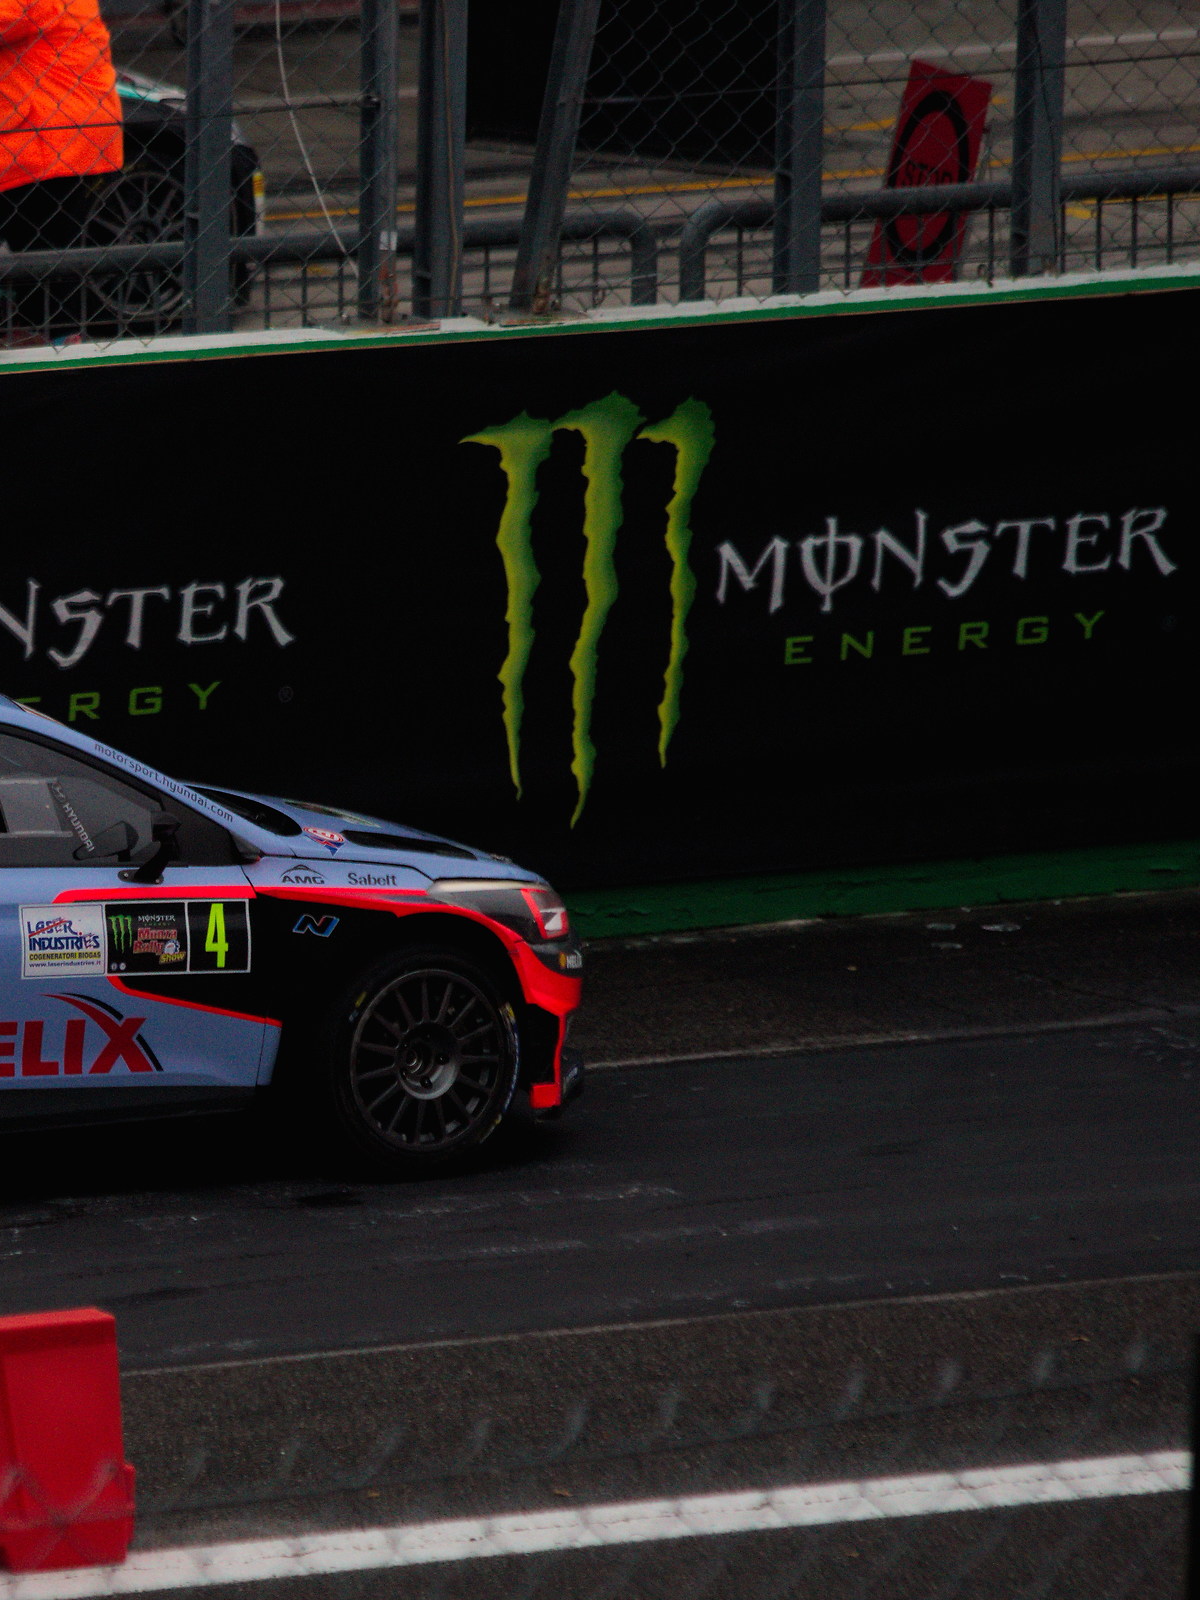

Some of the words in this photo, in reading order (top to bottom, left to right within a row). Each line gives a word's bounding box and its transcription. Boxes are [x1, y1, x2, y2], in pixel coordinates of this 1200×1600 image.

[715, 505, 1178, 615] MONSTER
[782, 610, 1106, 665] ENERGY
[94, 742, 235, 823] motorsport.hyundai.com
[27, 916, 78, 937] LASER
[137, 914, 176, 923] MONSTER
[204, 903, 230, 968] 4
[29, 933, 101, 951] INDUSTRIES
[29, 951, 77, 961] COGENERATORI
[77, 950, 101, 960] BIOGAS
